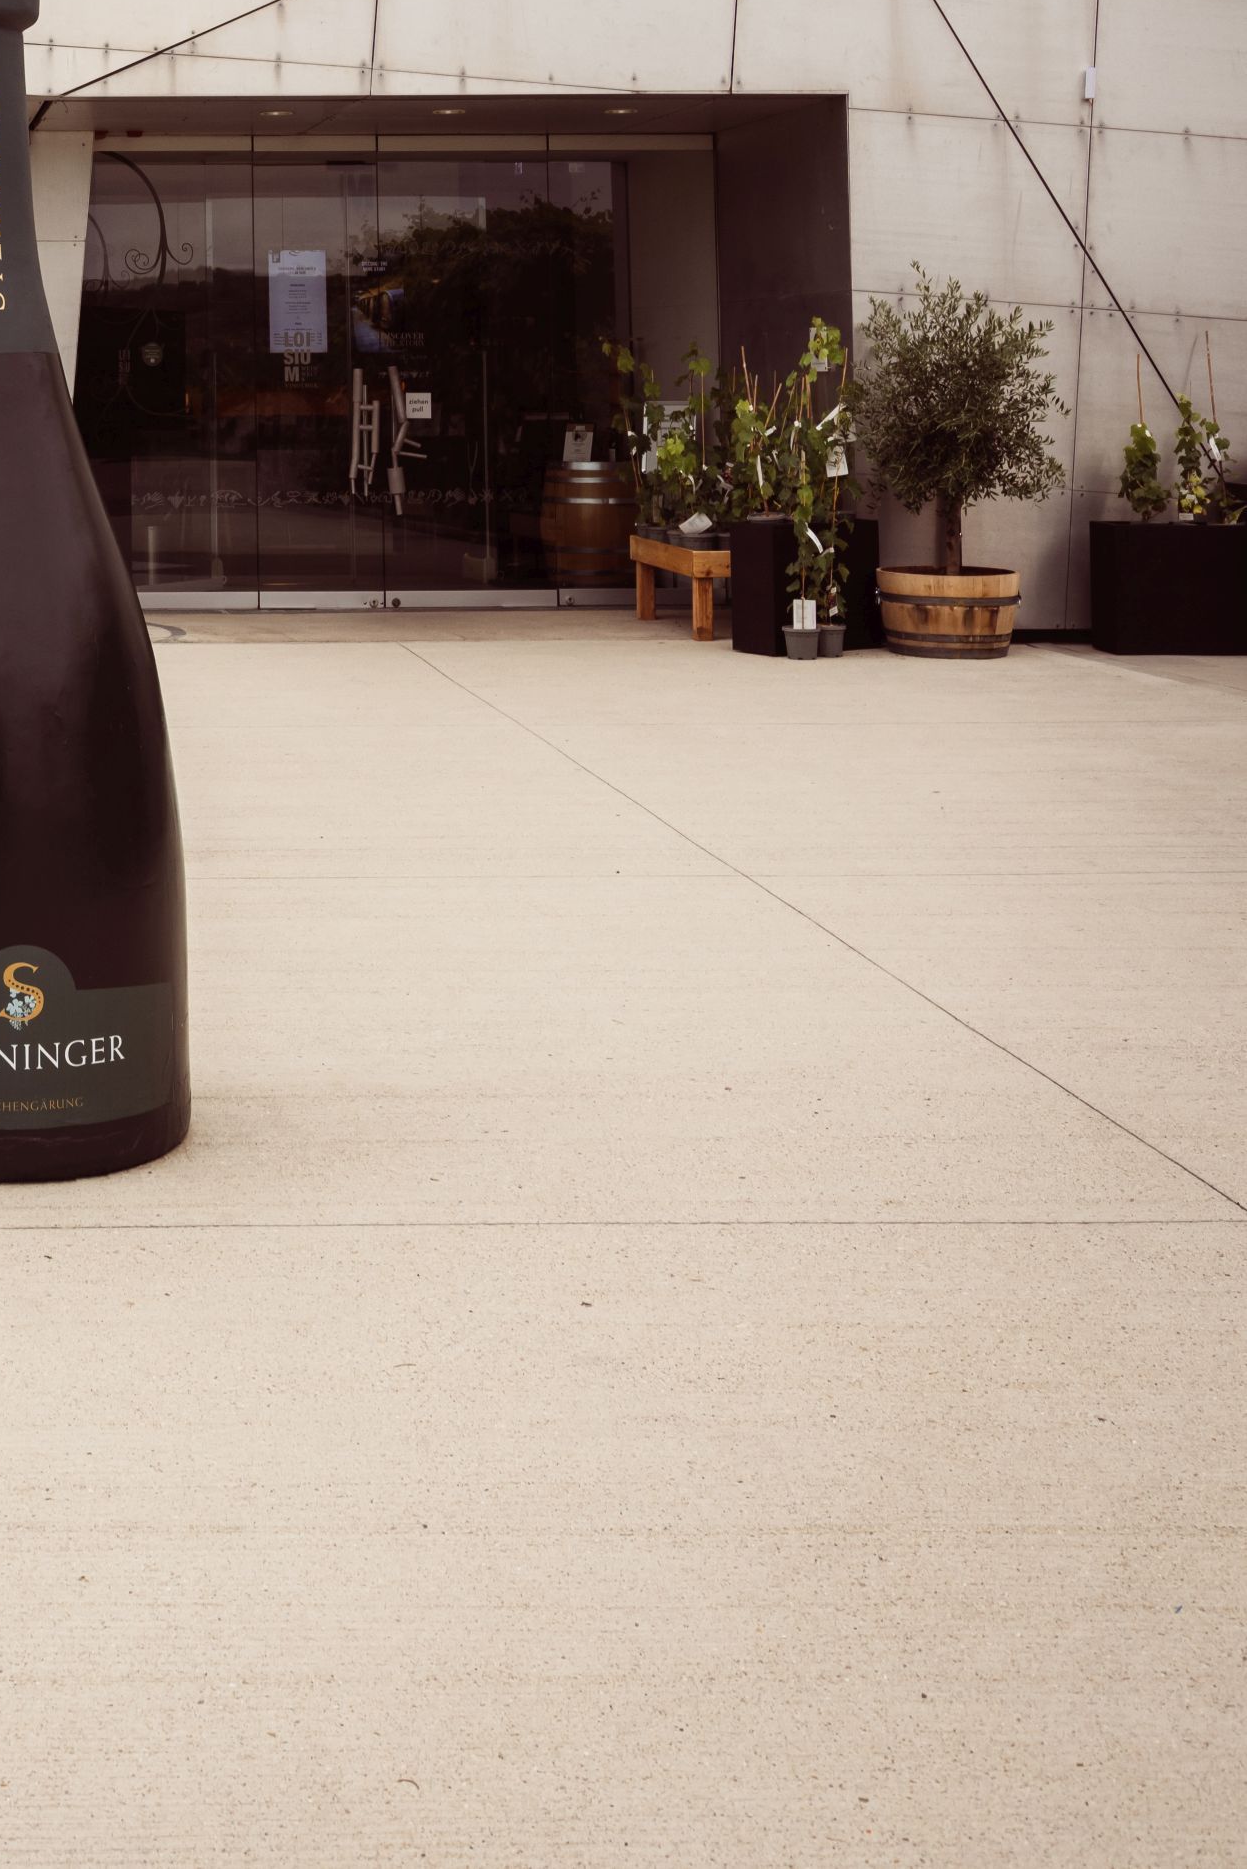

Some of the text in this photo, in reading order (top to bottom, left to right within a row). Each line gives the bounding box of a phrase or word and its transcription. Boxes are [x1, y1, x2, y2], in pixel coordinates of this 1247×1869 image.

[283, 332, 311, 347] LOI
[283, 348, 311, 365] SIU
[412, 405, 424, 413] pull
